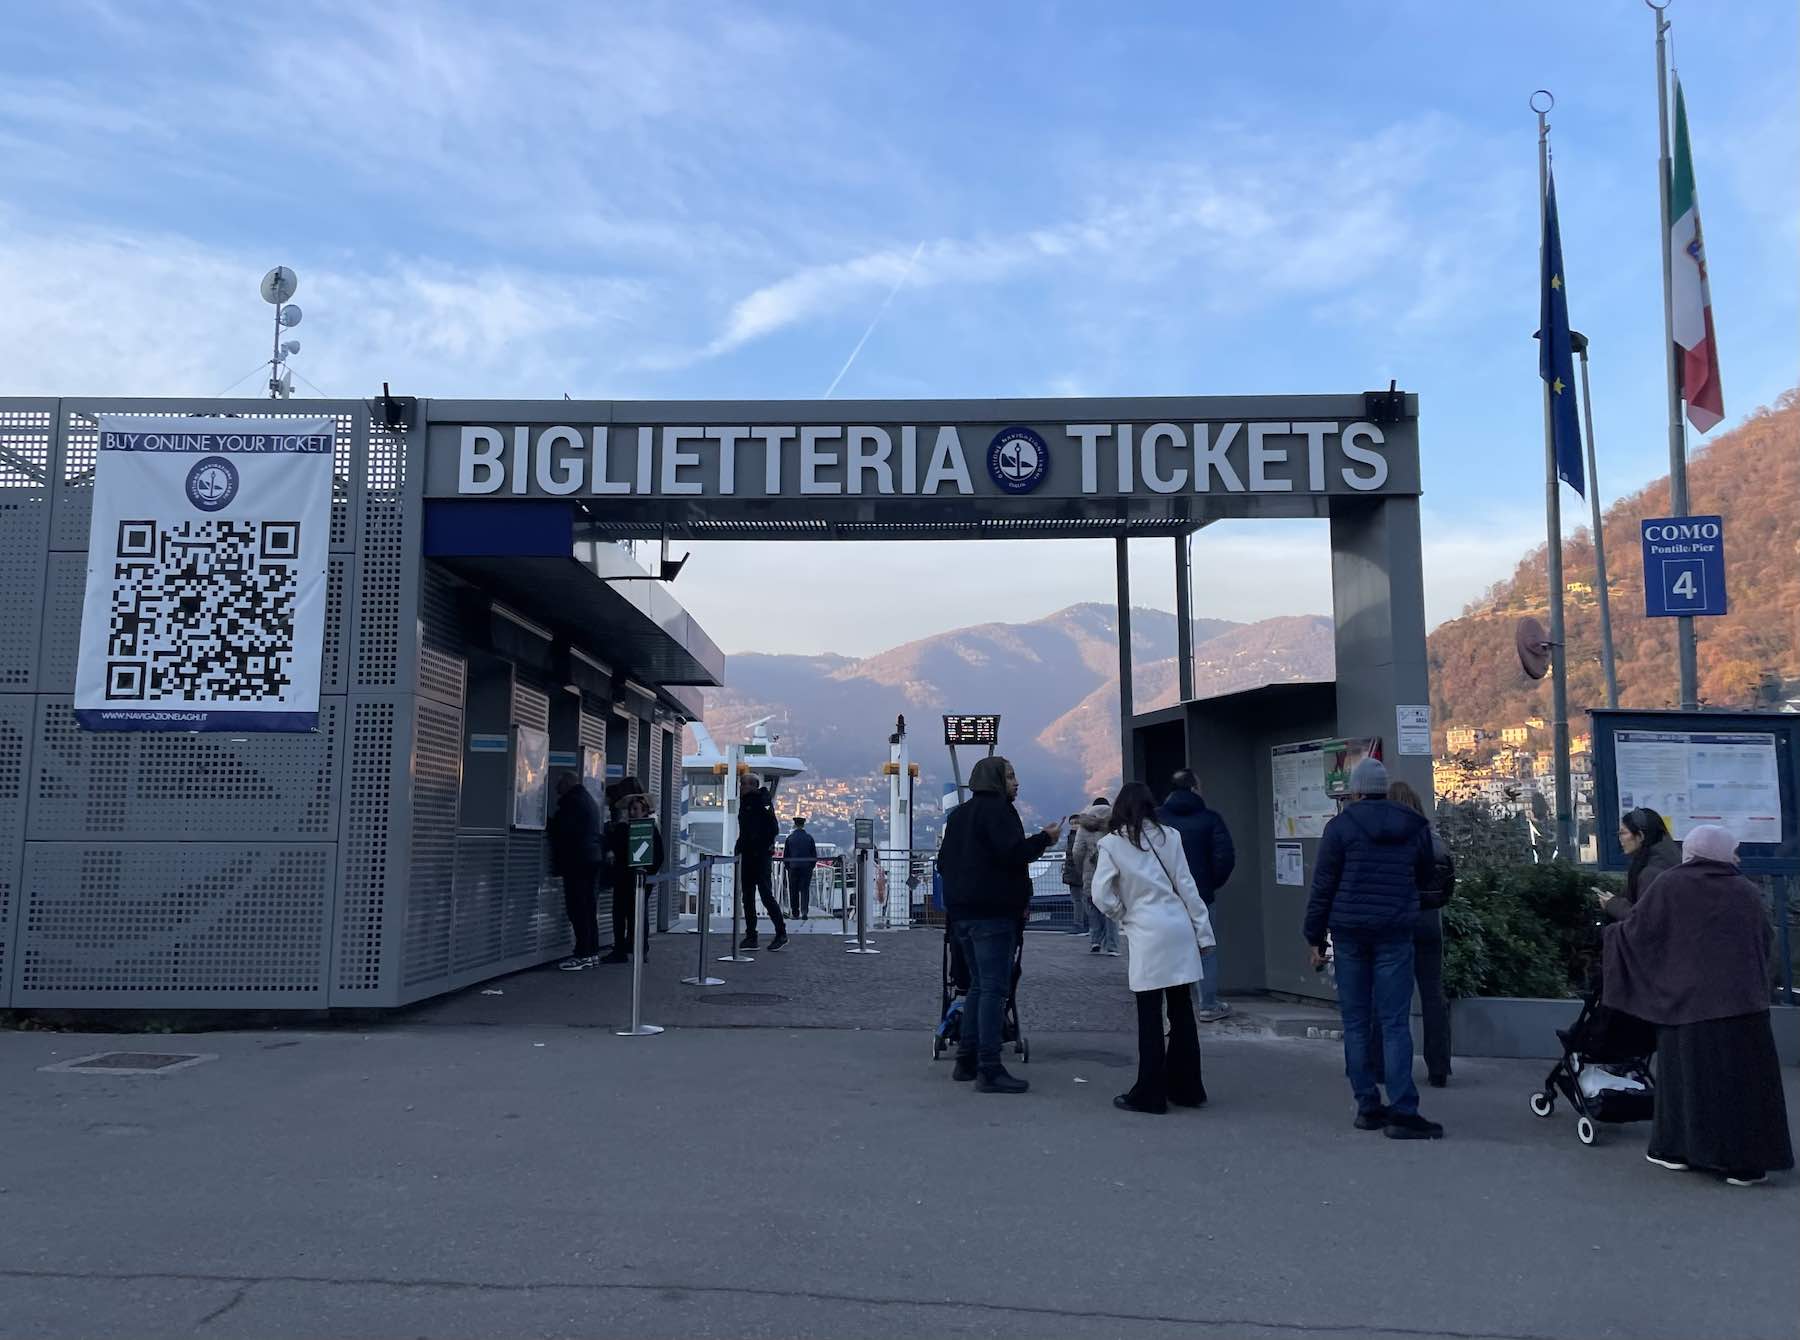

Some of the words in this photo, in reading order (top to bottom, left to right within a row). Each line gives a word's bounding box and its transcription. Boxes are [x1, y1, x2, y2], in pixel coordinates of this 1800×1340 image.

[106, 433, 139, 449] BUY
[144, 434, 210, 450] ONLINE
[216, 435, 265, 451] YOUR
[270, 435, 327, 451] TICKET
[458, 425, 975, 495] BIGLIETTERIA
[1066, 422, 1388, 493] TICKETS
[1645, 523, 1719, 541] COMO
[1672, 571, 1697, 600] 4
